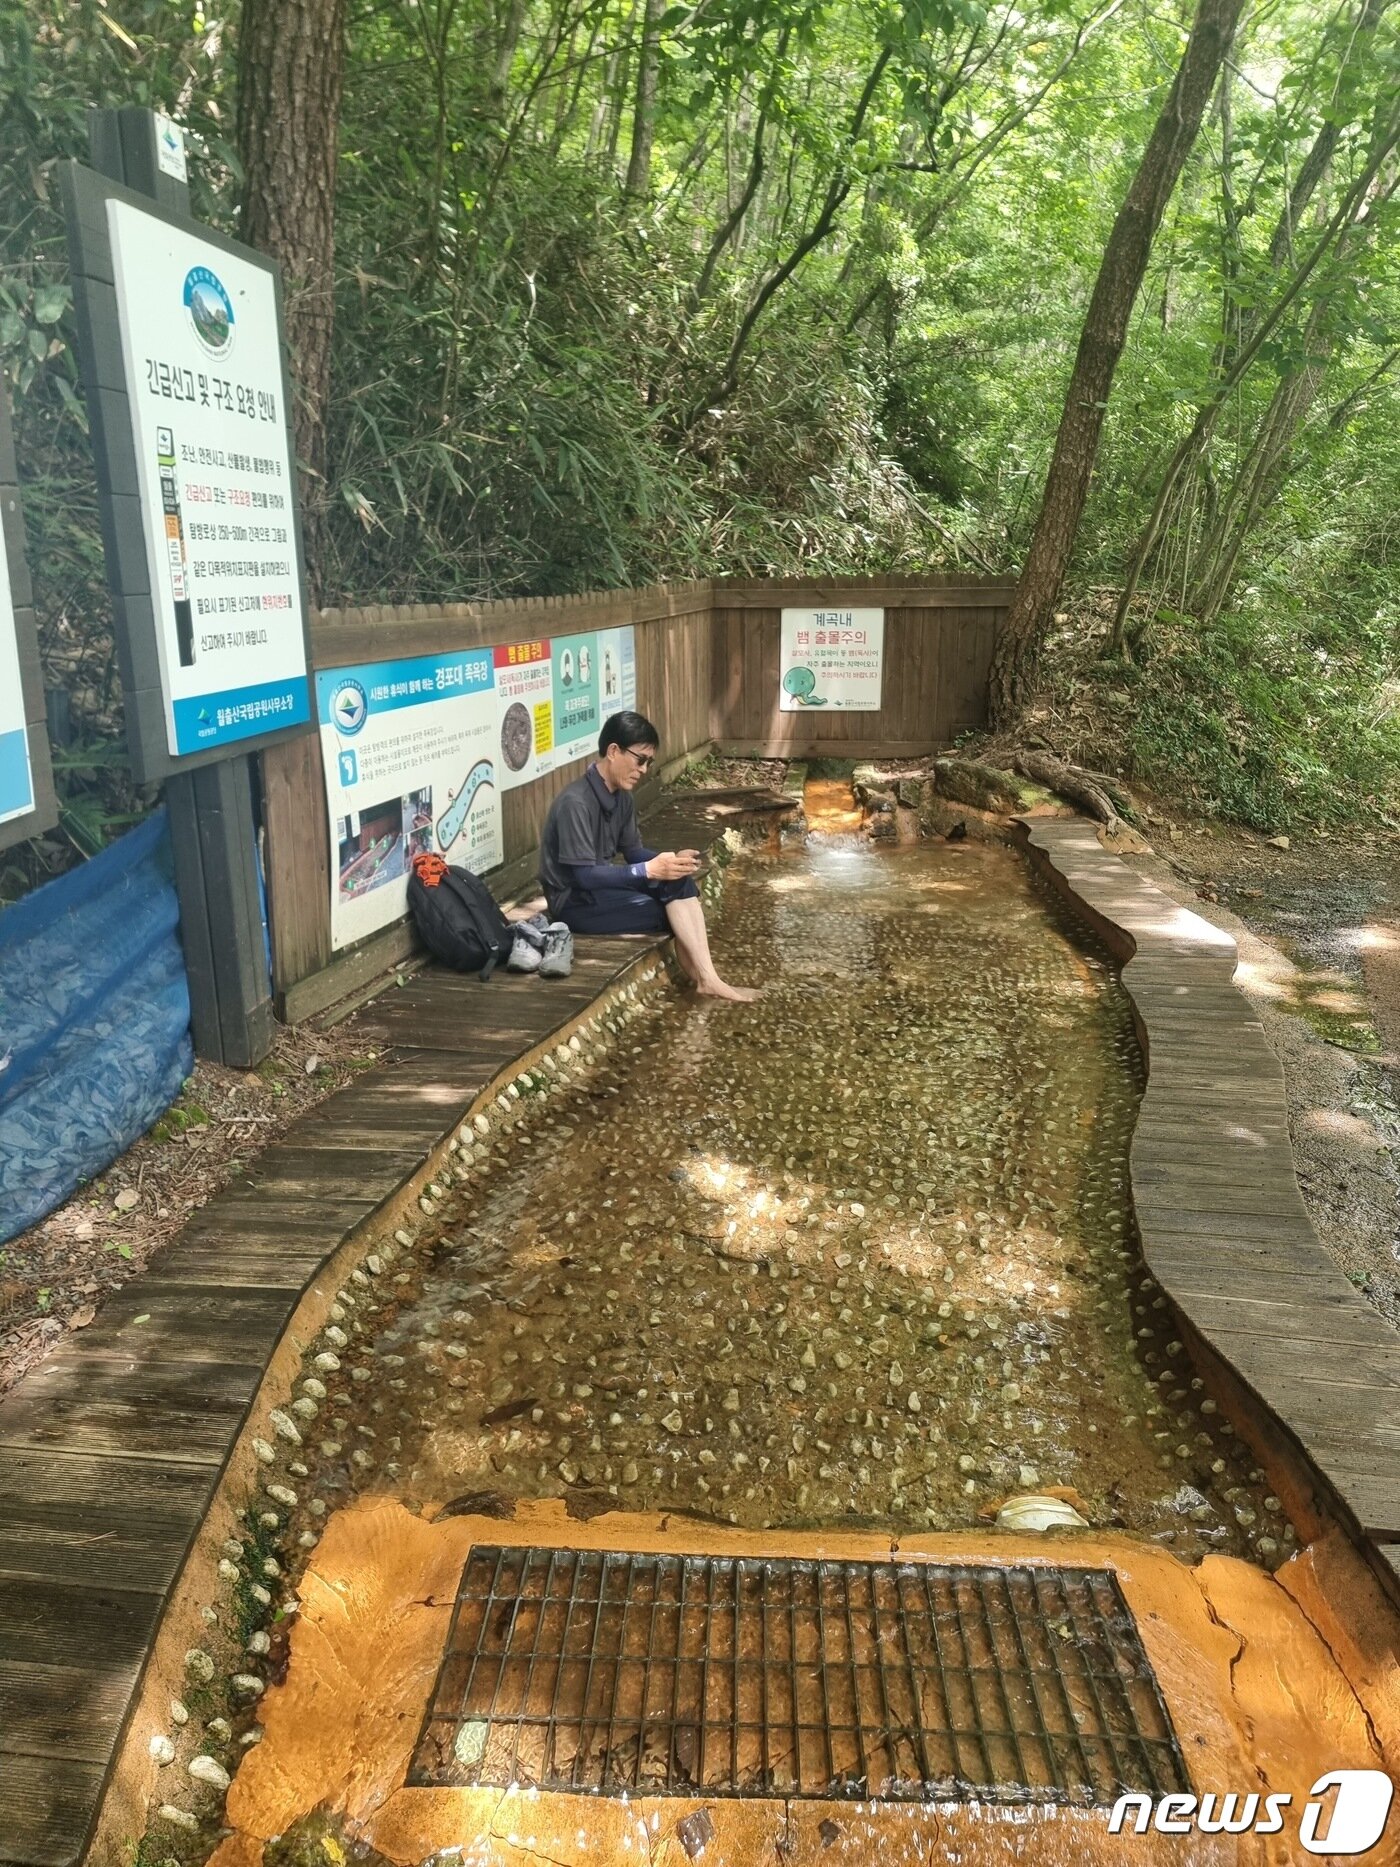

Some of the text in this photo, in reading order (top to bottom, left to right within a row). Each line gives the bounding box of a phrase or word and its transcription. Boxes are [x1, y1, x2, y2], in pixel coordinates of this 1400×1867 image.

[145, 359, 276, 423] 긴급신고 및 구조 요청 안내
[181, 444, 197, 463] 조난,
[198, 447, 226, 467] 안전사고,
[185, 484, 212, 502] 긴급신고
[213, 487, 226, 505] 또는
[228, 489, 250, 507] 구조요청
[252, 492, 268, 508] 편의를
[189, 523, 216, 540] 탐방로상
[248, 527, 270, 542] 간격으로
[271, 528, 287, 543] 그림과
[193, 561, 206, 577] 같은
[208, 561, 259, 576] 다목적위치표지판을
[197, 598, 217, 615] 필요시
[218, 597, 236, 613] 표기된
[238, 595, 260, 612] 신고처에
[813, 612, 852, 627] 계곡내
[201, 634, 225, 651] 신고하여
[227, 632, 245, 648] 주시기
[797, 631, 809, 645] 뱀
[508, 642, 542, 664] 뱀 출몰 주의
[807, 660, 878, 668] 자주 출몰하는 지역이오니
[370, 660, 488, 701] 시원한 휴식이 함께 하는 경포대 족욕장
[821, 671, 878, 679] 주의하시기 바랍니다
[216, 694, 293, 727] 월출산국립공원사무소장
